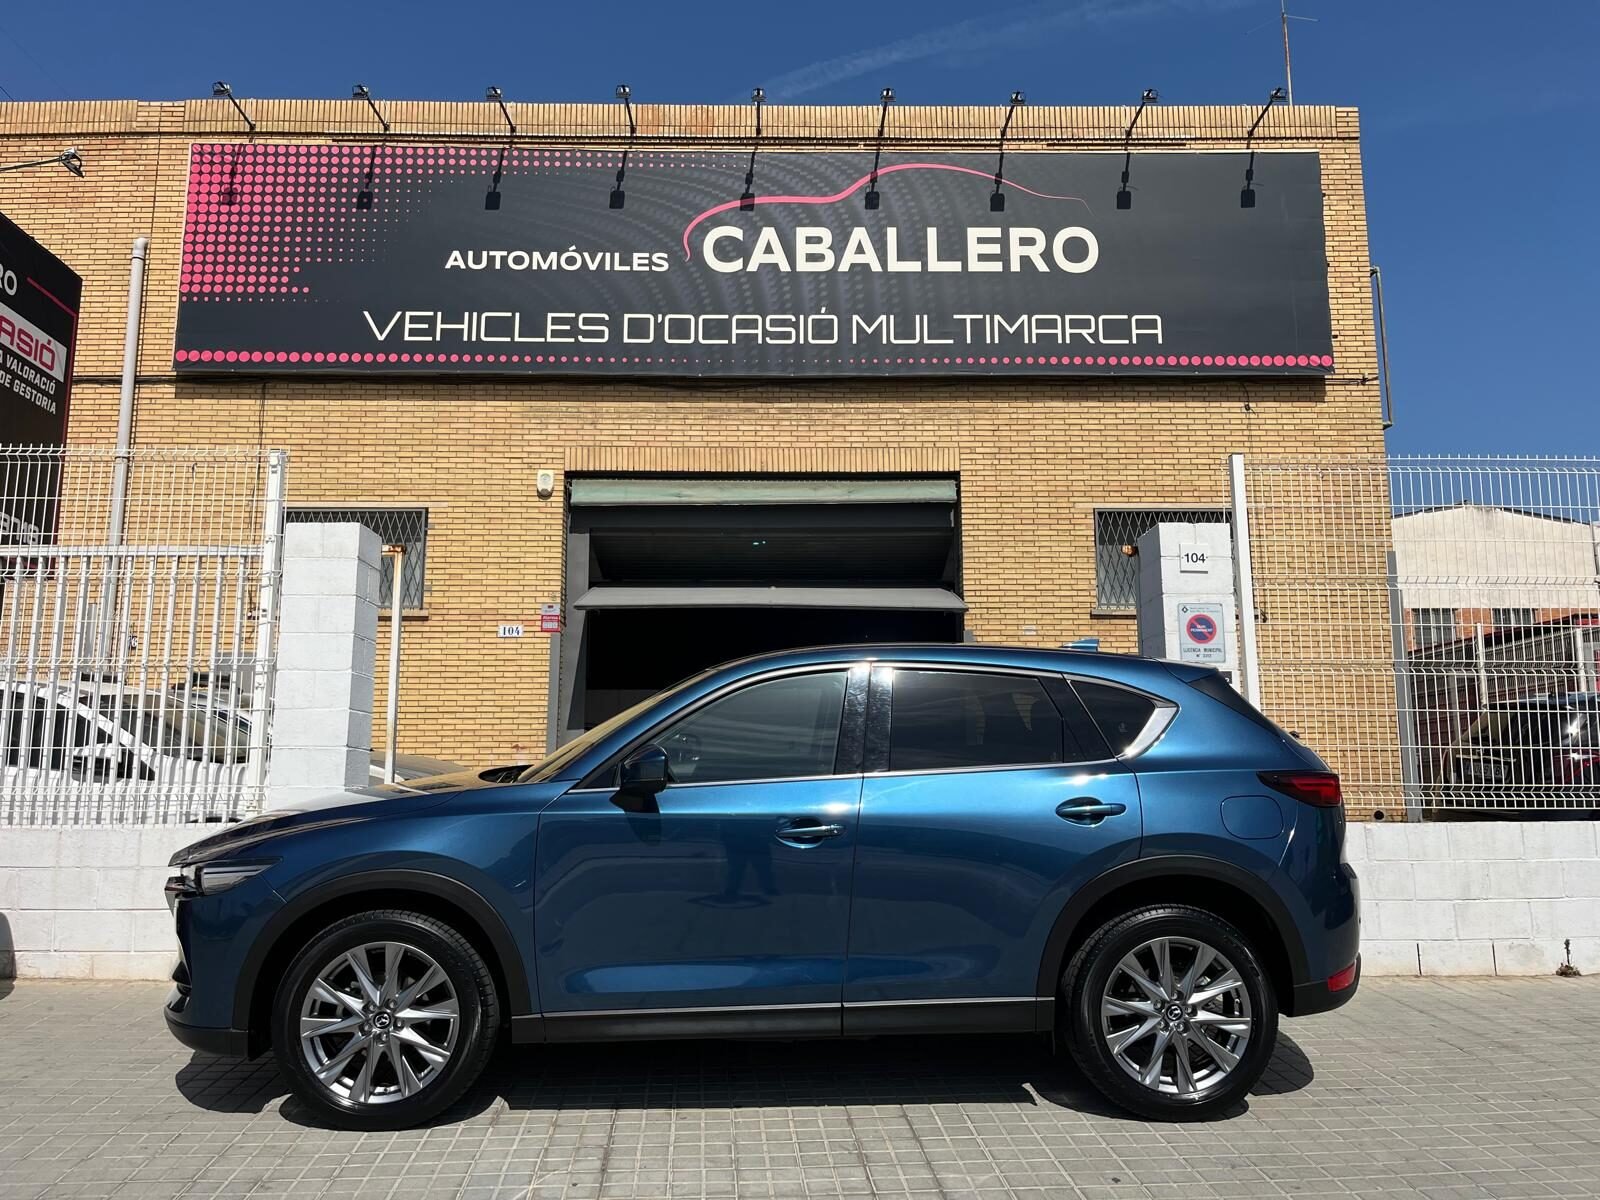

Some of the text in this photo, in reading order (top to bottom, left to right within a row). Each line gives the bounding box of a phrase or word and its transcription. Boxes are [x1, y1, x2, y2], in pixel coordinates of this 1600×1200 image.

[445, 226, 1099, 274] AUTOMÓVILES CABALLERO
[363, 306, 1163, 345] VEHICLES D'OCASIÓ MULTIMARCA
[6, 354, 56, 395] VALORACIÓ
[13, 379, 56, 415] GESTORIA
[1184, 553, 1206, 563] 104
[503, 627, 519, 636] 104
